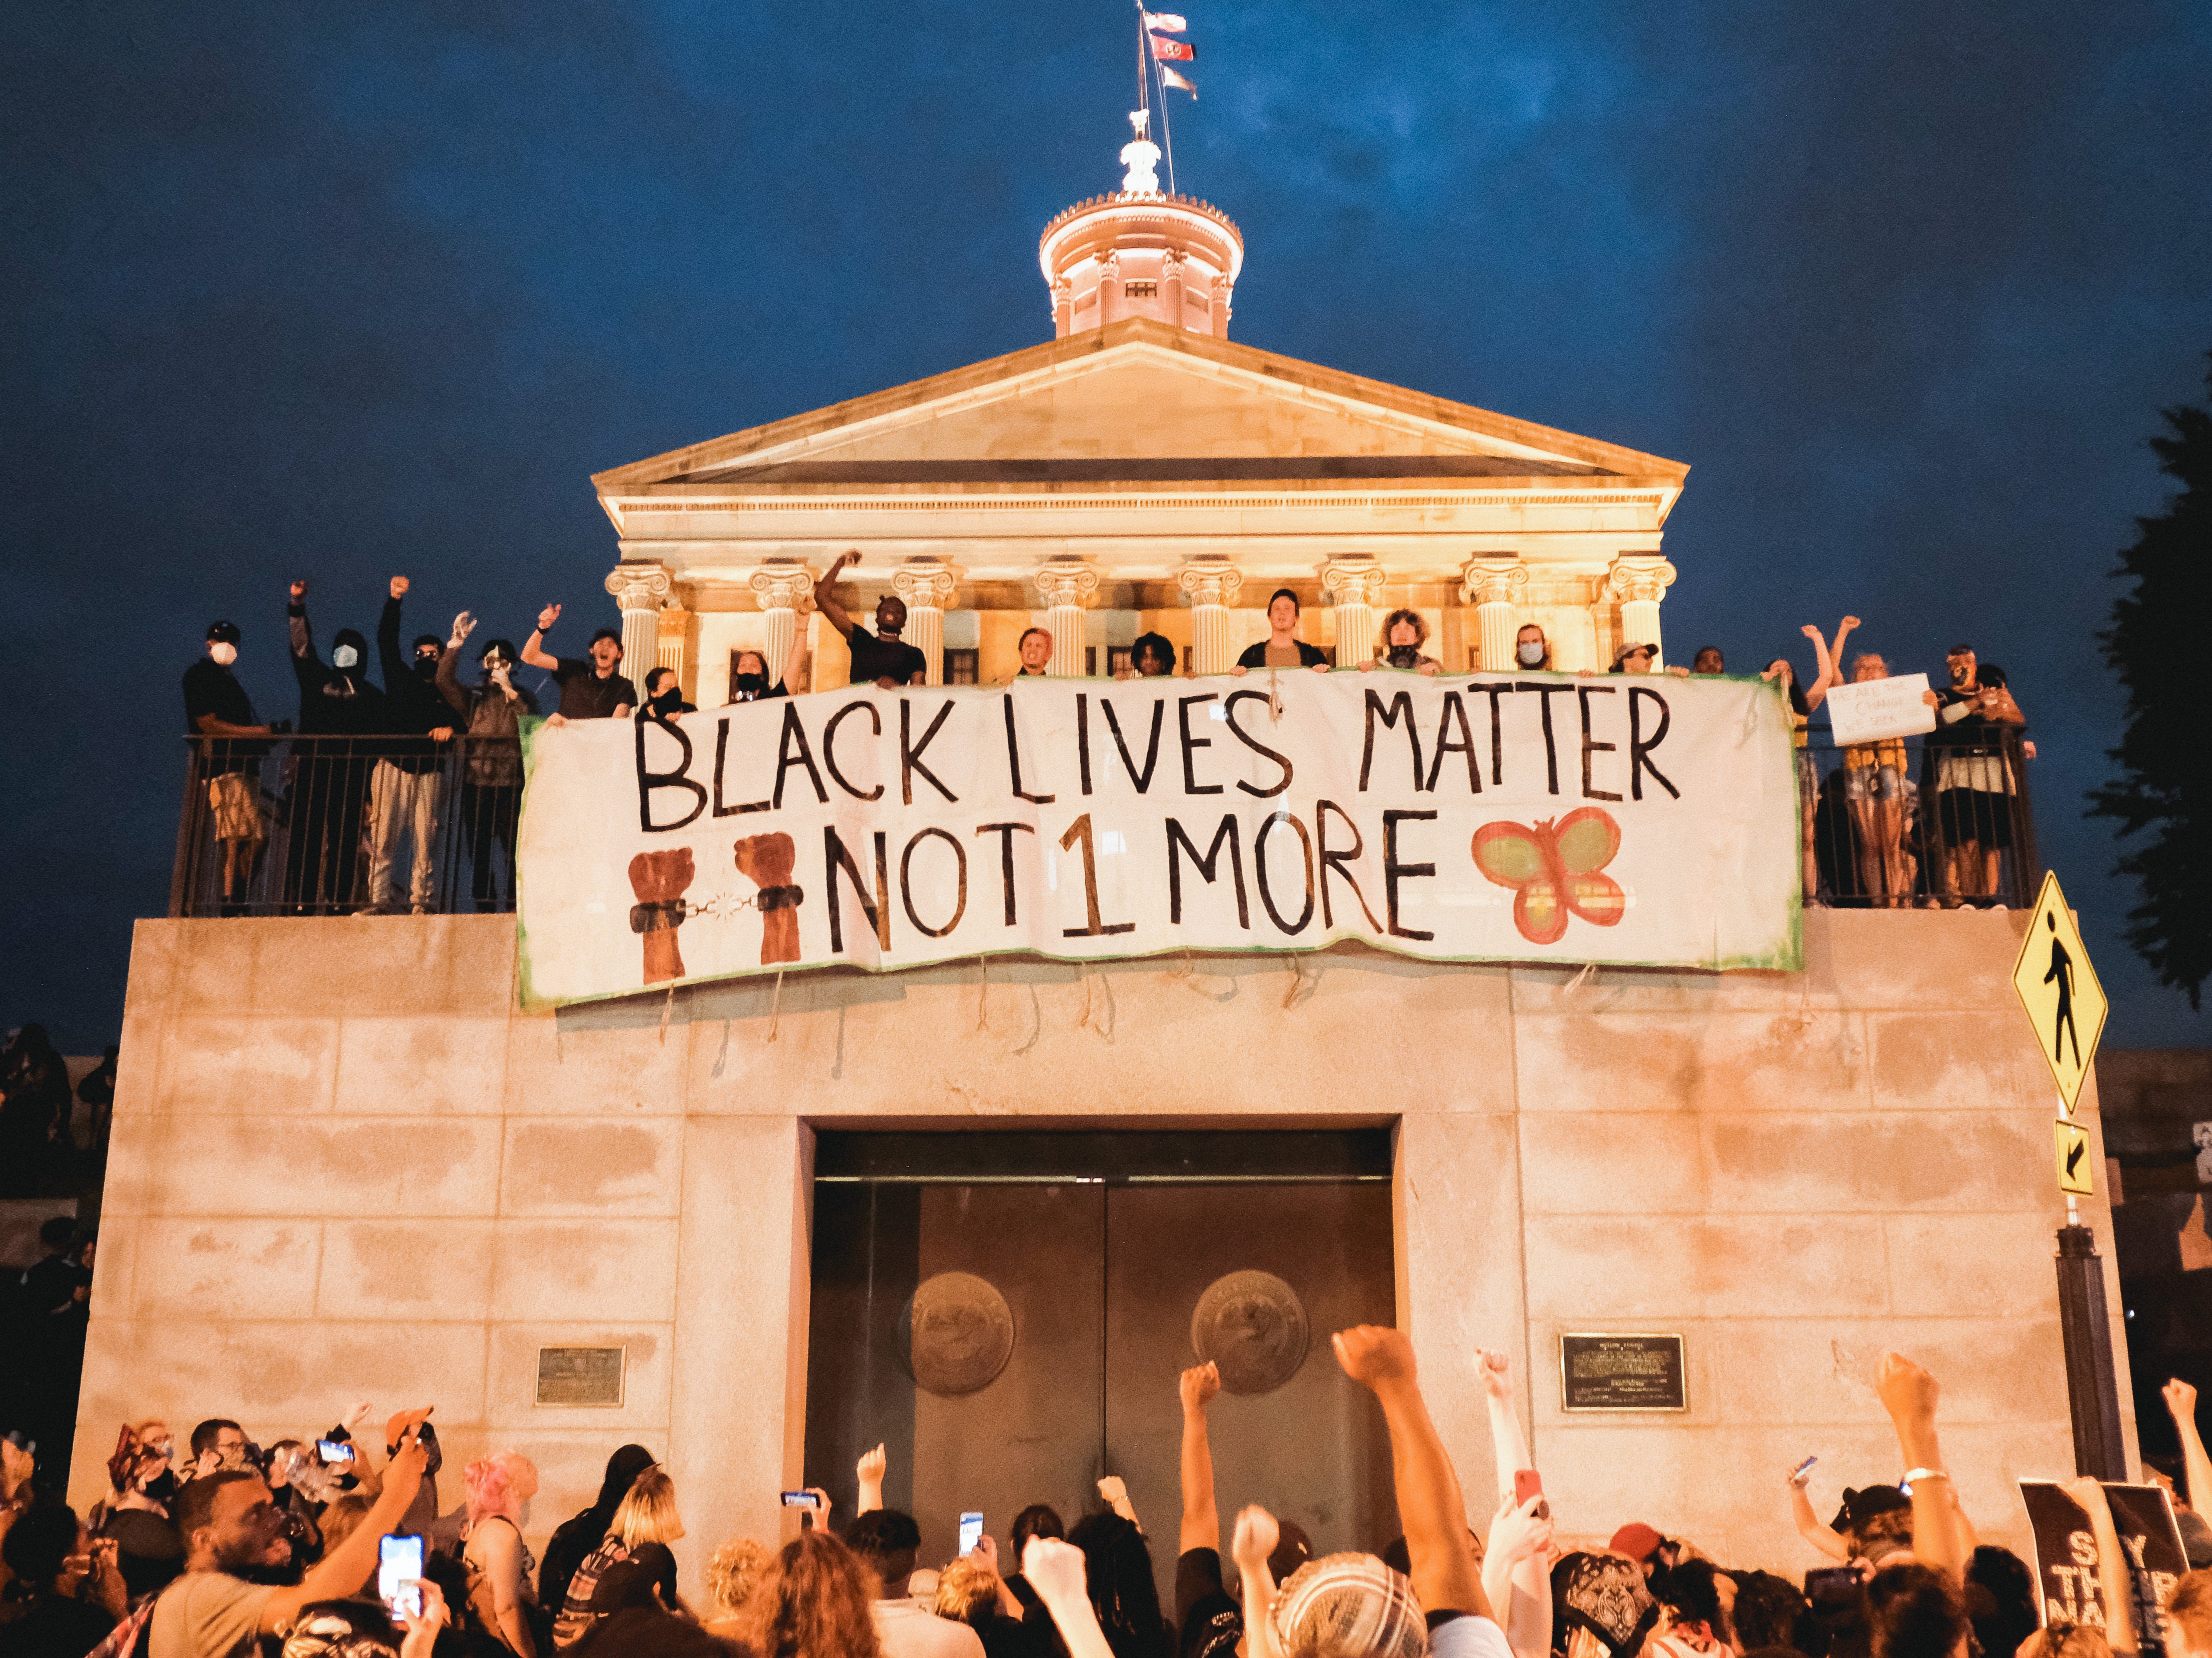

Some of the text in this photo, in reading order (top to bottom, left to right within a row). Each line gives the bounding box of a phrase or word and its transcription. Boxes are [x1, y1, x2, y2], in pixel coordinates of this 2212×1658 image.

[634, 681, 1681, 833] BLACK LIVES MATTER
[824, 800, 1437, 953] NOT 1 MORE
[2069, 1530, 2147, 1568] SY
